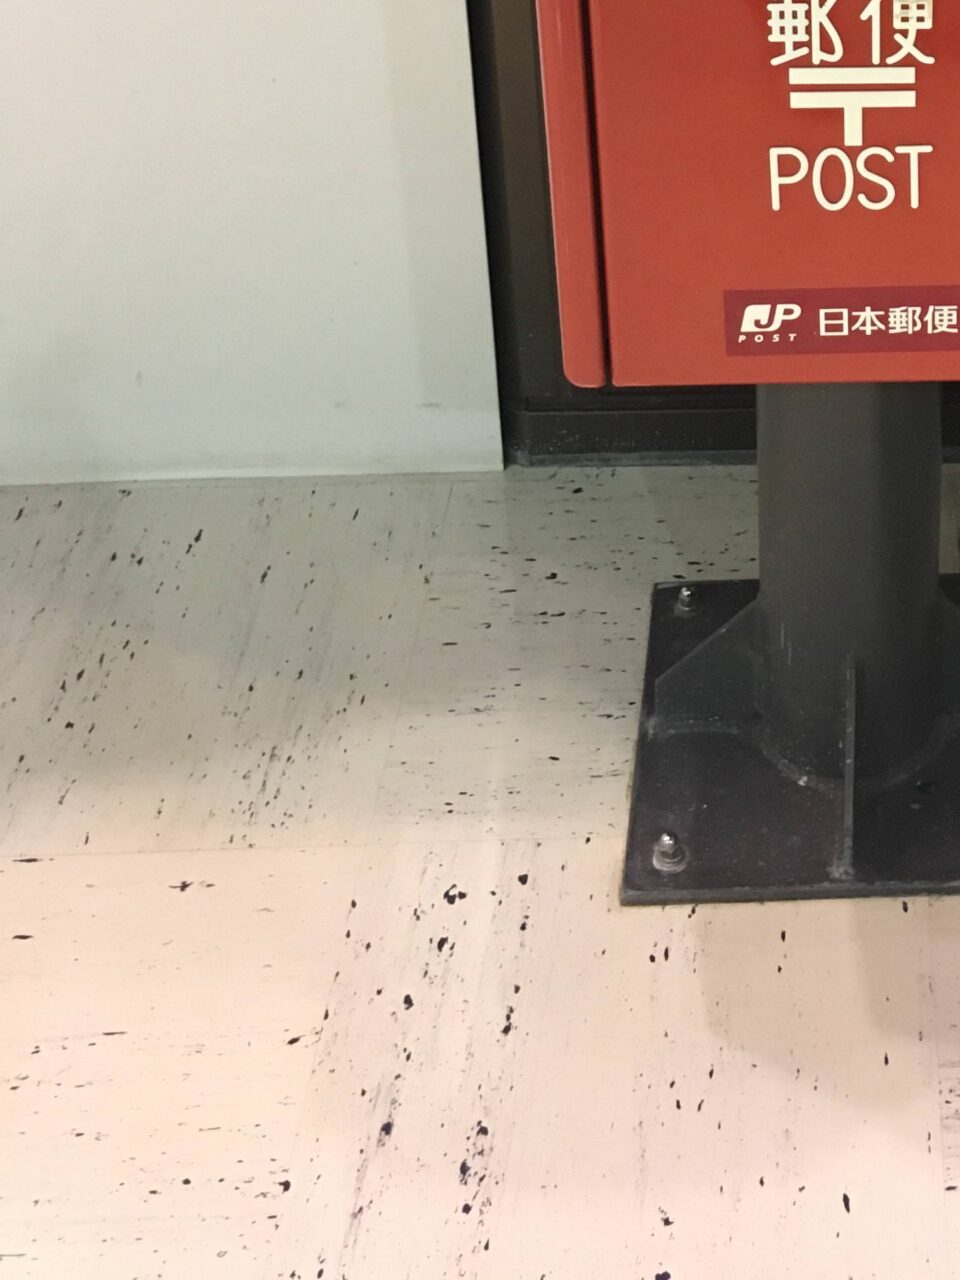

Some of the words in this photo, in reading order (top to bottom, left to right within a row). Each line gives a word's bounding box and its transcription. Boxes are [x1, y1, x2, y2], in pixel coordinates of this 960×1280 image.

[769, 145, 933, 211] POST
[819, 305, 959, 336] 日本郵便
[738, 334, 797, 343] POST
